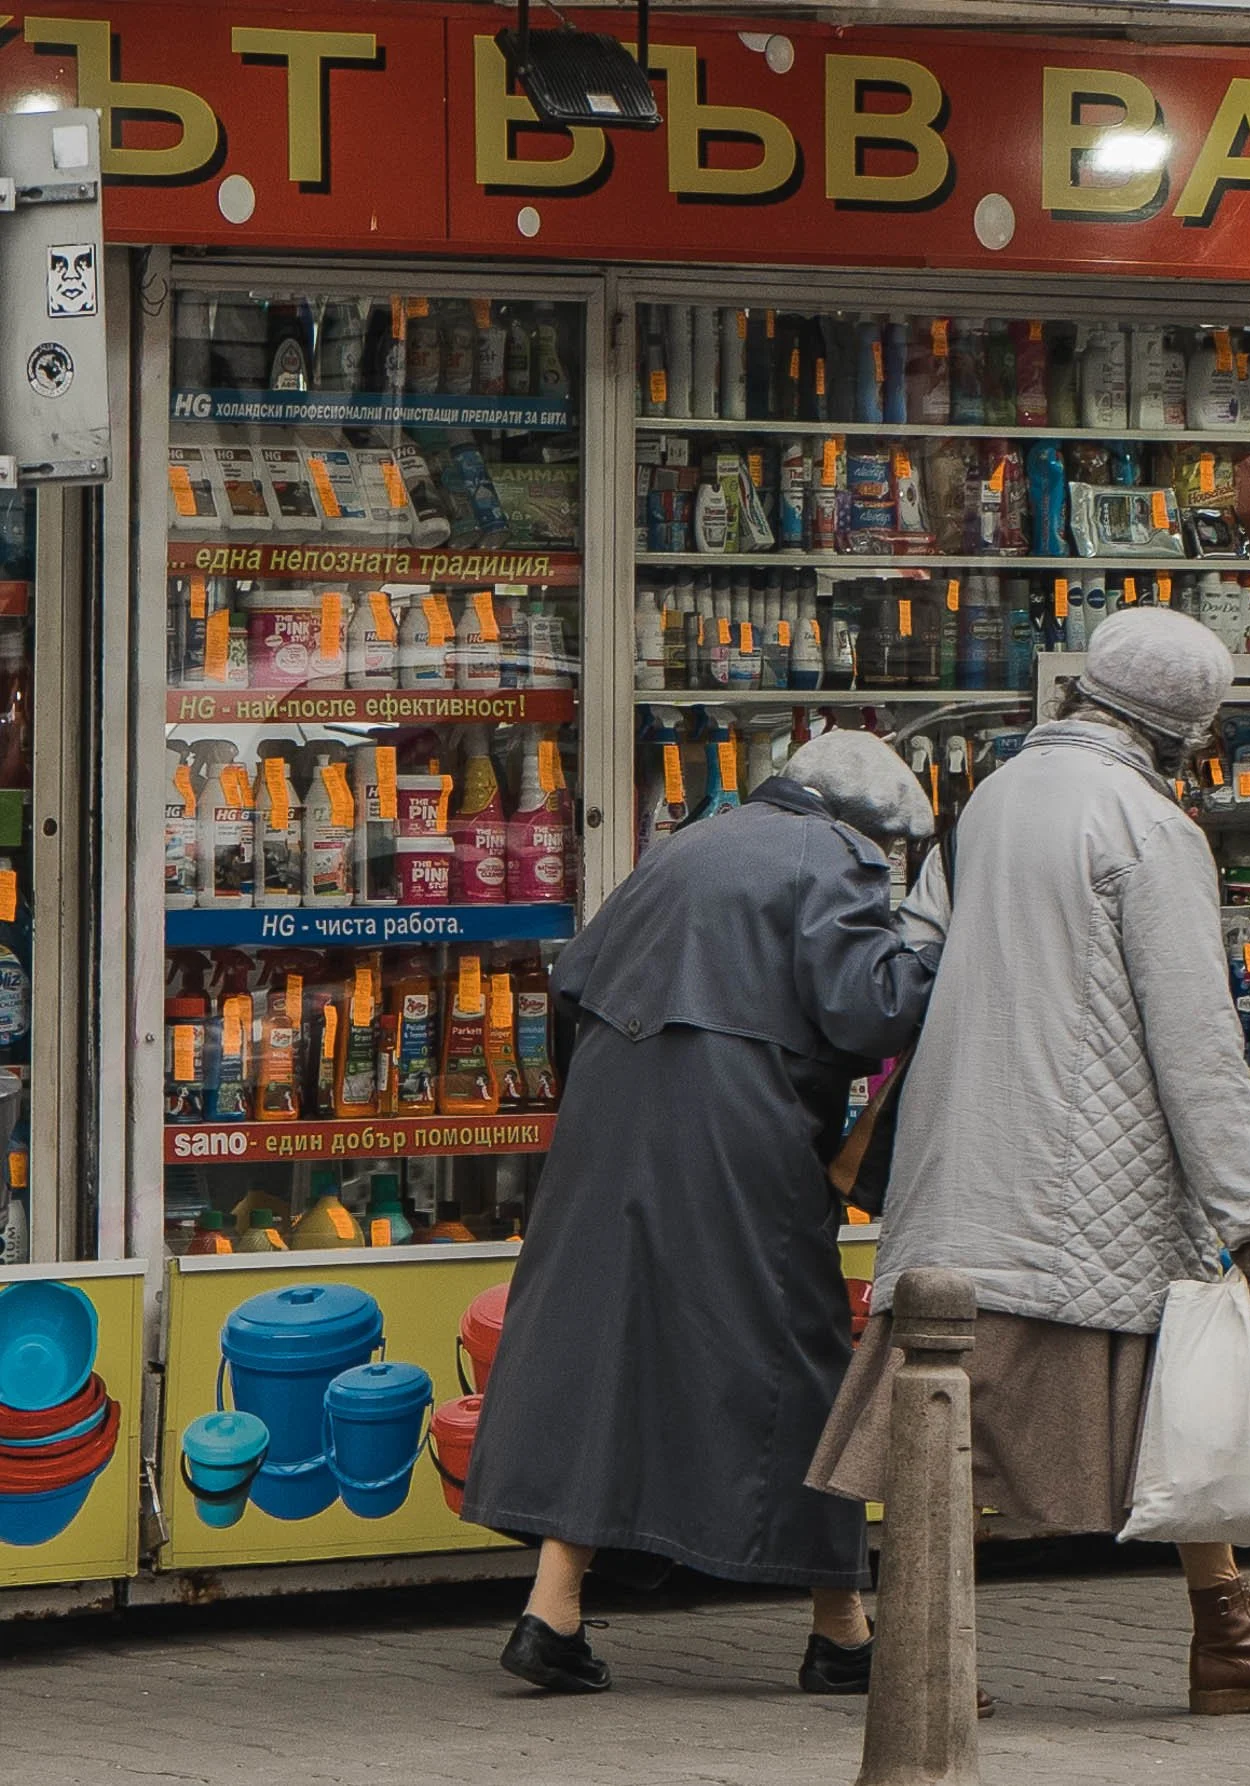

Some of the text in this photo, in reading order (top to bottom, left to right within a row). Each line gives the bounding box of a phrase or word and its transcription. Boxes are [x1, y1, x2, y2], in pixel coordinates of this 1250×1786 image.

[0, 15, 377, 183] ЪТ
[174, 393, 567, 425] HG ХОЛАНДСКИ ПРОФЕСИОНАЛНИ ПОЧИСТВАЩИ ПРЕПАРАТИ ЗА БИТА
[263, 451, 282, 461] HG
[195, 548, 261, 574] една
[270, 549, 411, 574] непозната
[419, 554, 555, 581] традиция.
[179, 695, 216, 719] HG
[237, 694, 356, 719] най-после
[366, 693, 525, 721] ефективност!
[216, 808, 237, 821] HG
[409, 806, 438, 819] PIN
[412, 869, 448, 882] PINK
[262, 914, 295, 937] HG
[315, 917, 377, 936] чиста
[384, 912, 464, 940] работа.
[174, 1131, 248, 1157] sano
[266, 1133, 323, 1156] един
[331, 1126, 407, 1155] добър
